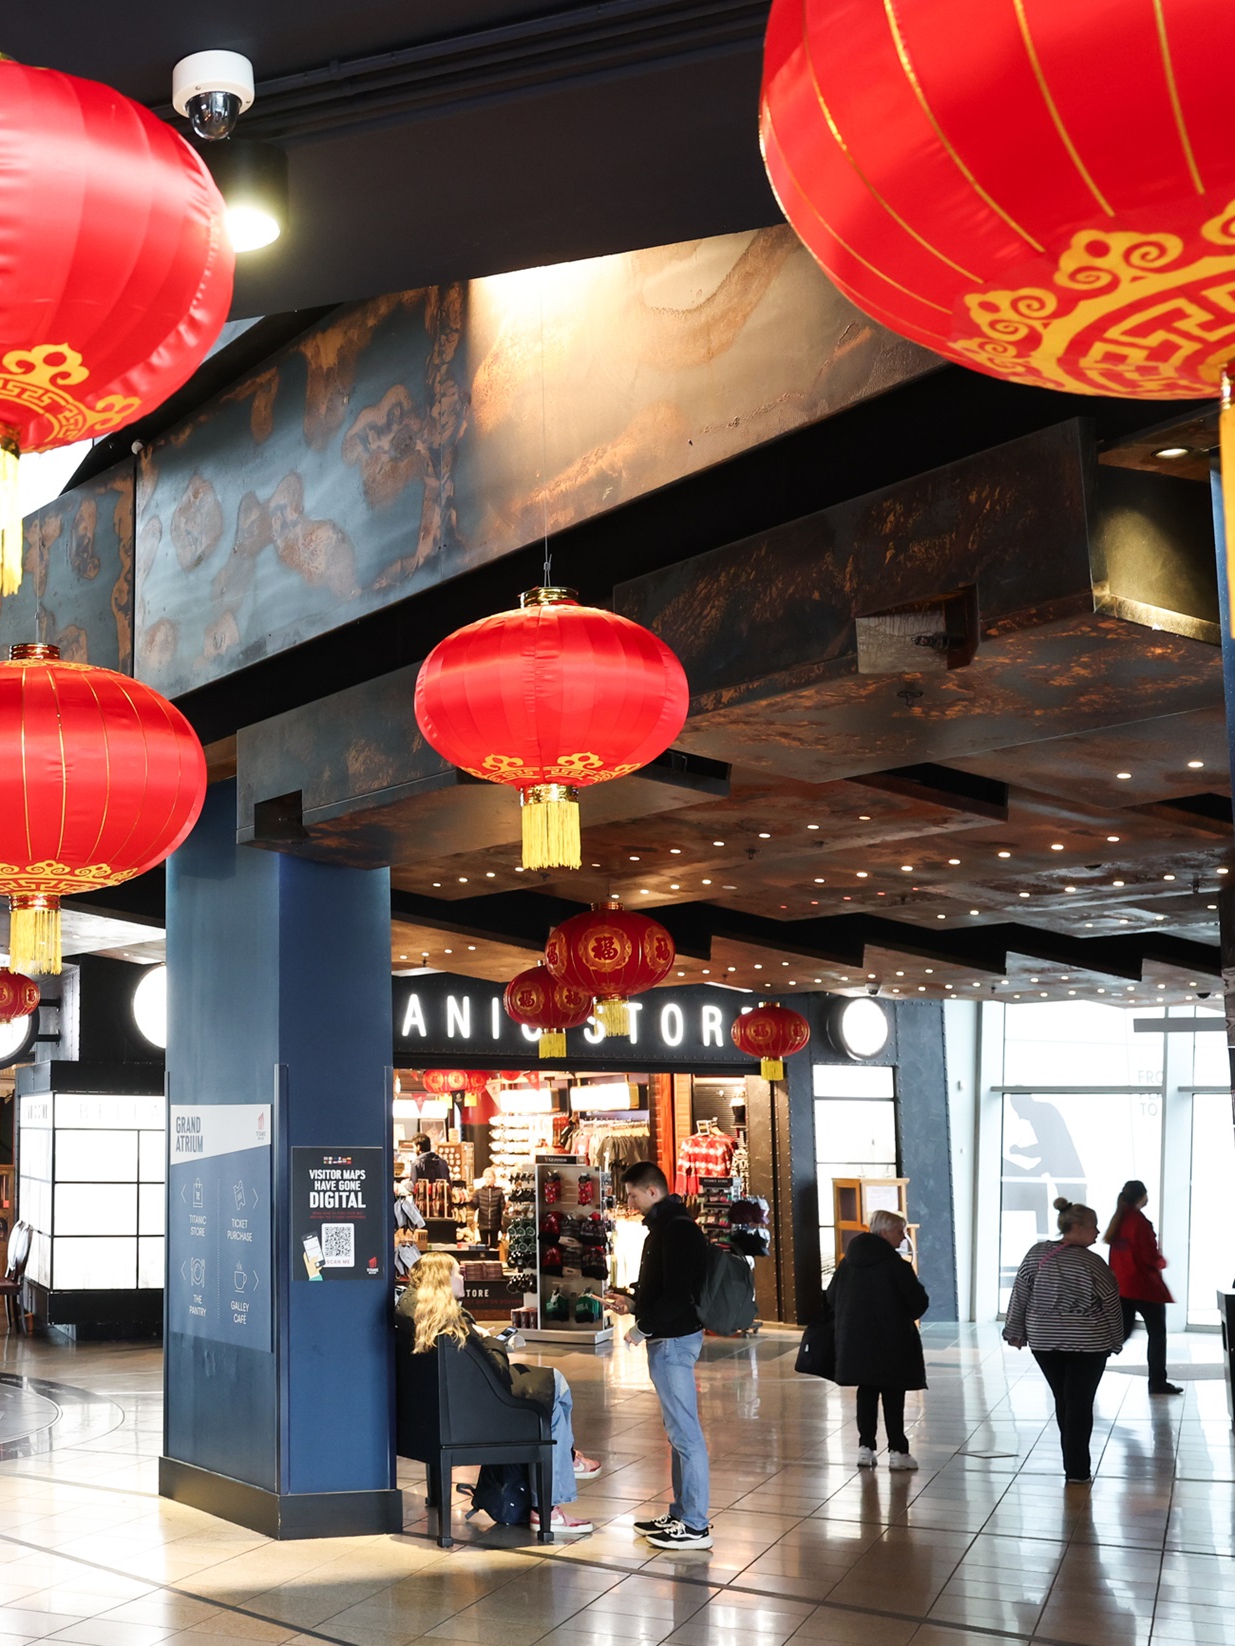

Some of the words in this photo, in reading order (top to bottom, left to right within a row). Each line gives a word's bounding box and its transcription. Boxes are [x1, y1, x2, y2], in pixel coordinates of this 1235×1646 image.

[591, 936, 619, 961] 福
[583, 997, 753, 1048] STOR
[1139, 1103, 1158, 1116] TO
[176, 1116, 201, 1134] GRAND
[175, 1135, 204, 1153] ATRIUM
[309, 1169, 342, 1180] VISITOR
[343, 1169, 366, 1180] MAPS
[314, 1181, 337, 1191] HAVE
[338, 1181, 361, 1191] GONE
[309, 1192, 366, 1209] DIGITAL
[189, 1215, 207, 1225] TITANIC
[231, 1218, 248, 1229] TICKET
[190, 1226, 206, 1237] STORE
[226, 1231, 253, 1243] PURCHASE
[193, 1294, 202, 1304] THE
[464, 1288, 490, 1298] TORE
[189, 1305, 207, 1317] PANTRY
[230, 1301, 250, 1313] GALLEY
[233, 1312, 247, 1325] CAFÉ
